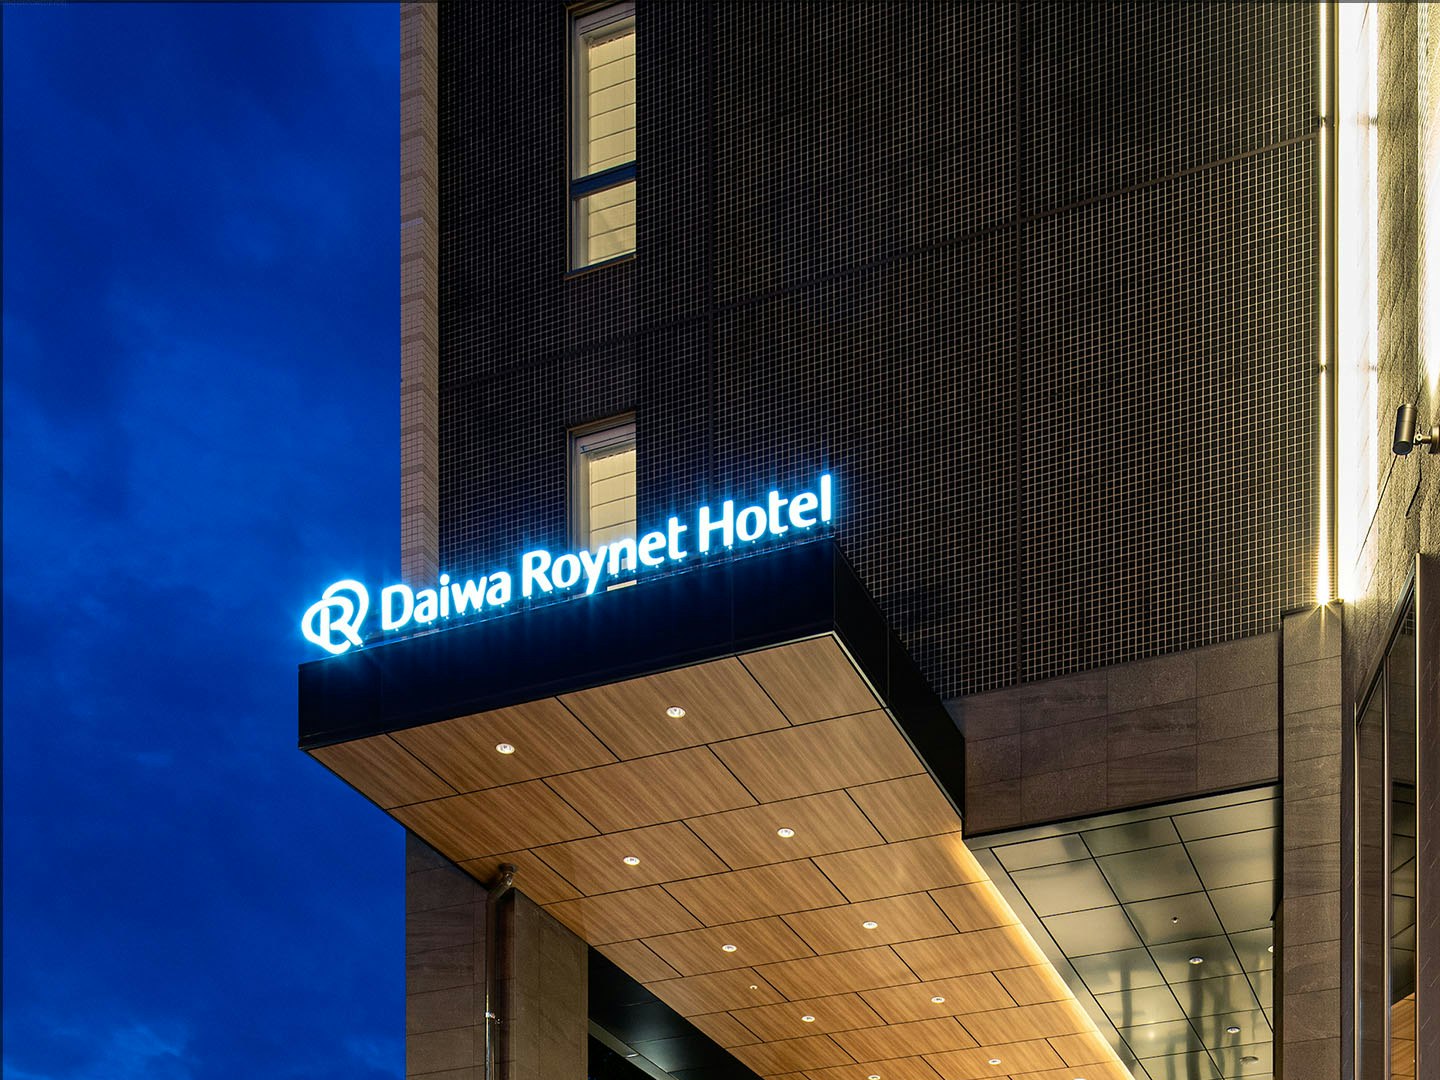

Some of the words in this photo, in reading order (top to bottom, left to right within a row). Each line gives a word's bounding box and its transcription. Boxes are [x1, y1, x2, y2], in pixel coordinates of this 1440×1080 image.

[381, 572, 512, 632] Daiwa
[522, 516, 688, 596] Roynet
[698, 474, 833, 554] Hotel
